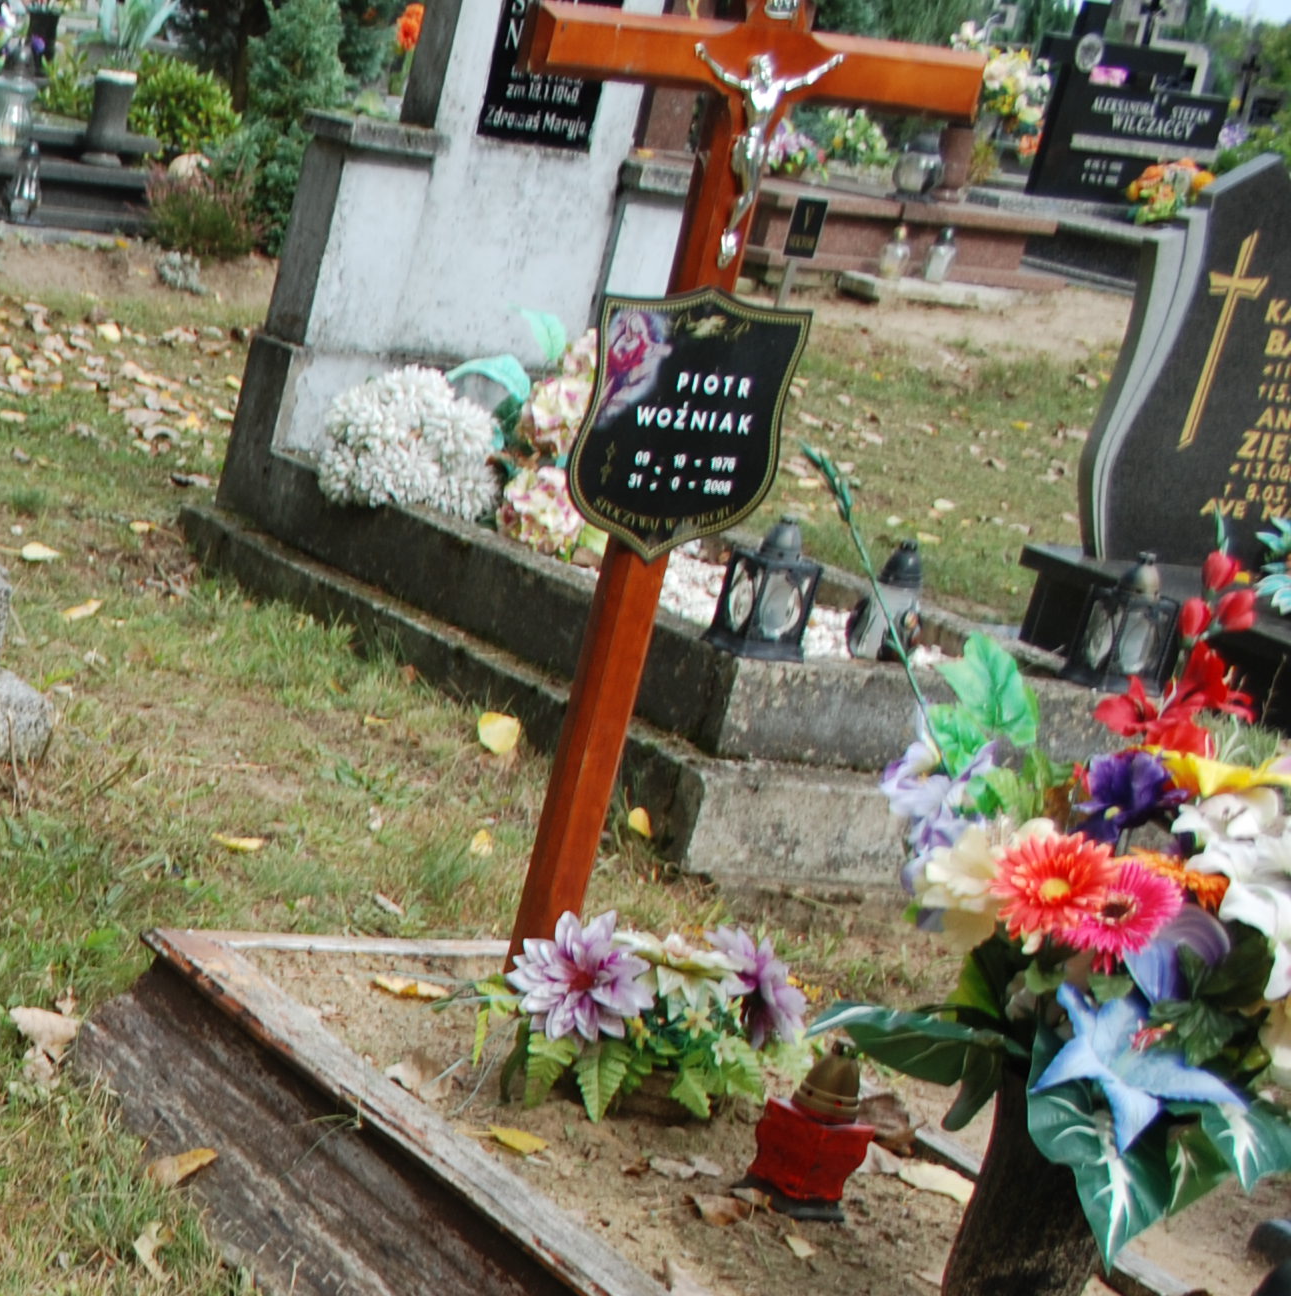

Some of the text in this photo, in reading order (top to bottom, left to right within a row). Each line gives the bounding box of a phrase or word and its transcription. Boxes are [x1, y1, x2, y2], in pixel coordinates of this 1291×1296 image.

[1112, 113, 1196, 141] WILCZACCY
[676, 371, 752, 399] PIOTR
[636, 402, 753, 436] WOŹNIAK
[1199, 498, 1247, 519] AVE
